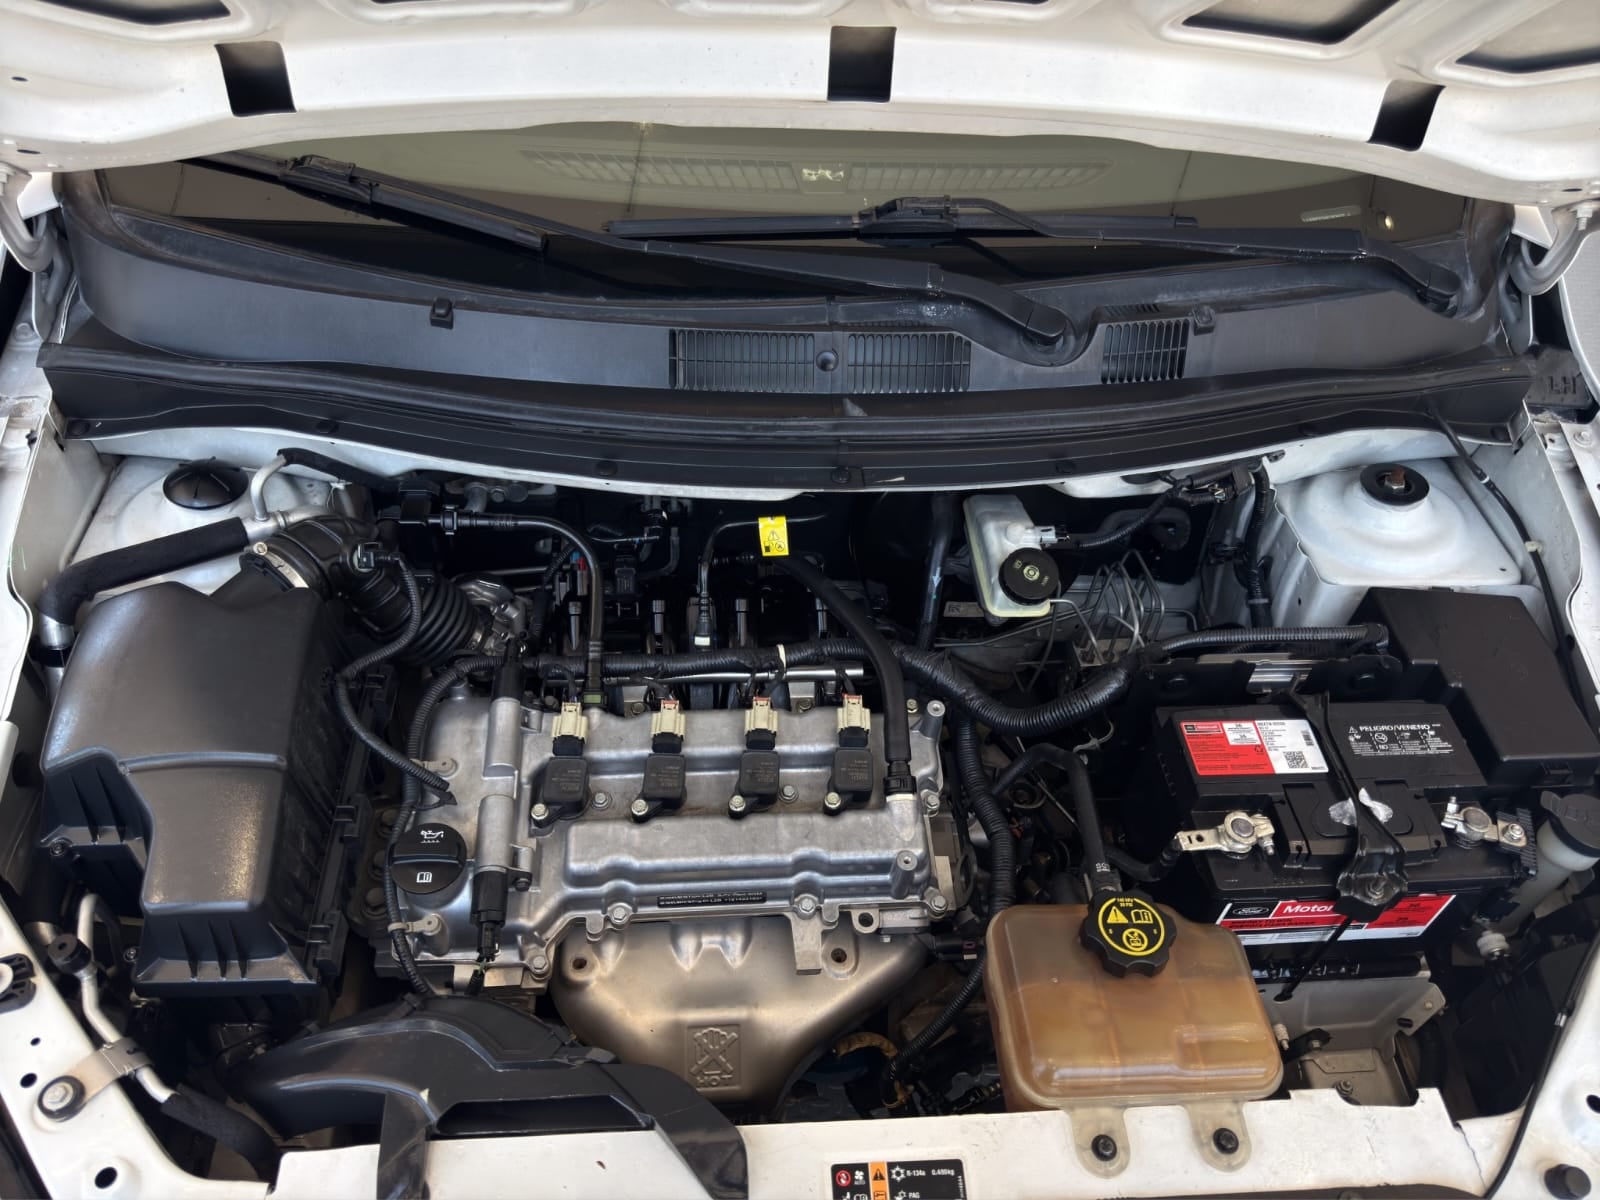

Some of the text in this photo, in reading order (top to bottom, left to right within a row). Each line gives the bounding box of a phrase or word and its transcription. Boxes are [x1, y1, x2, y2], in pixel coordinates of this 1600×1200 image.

[1549, 376, 1577, 395] LH
[695, 1075, 733, 1088] HOT
[908, 1191, 921, 1199] PAG
